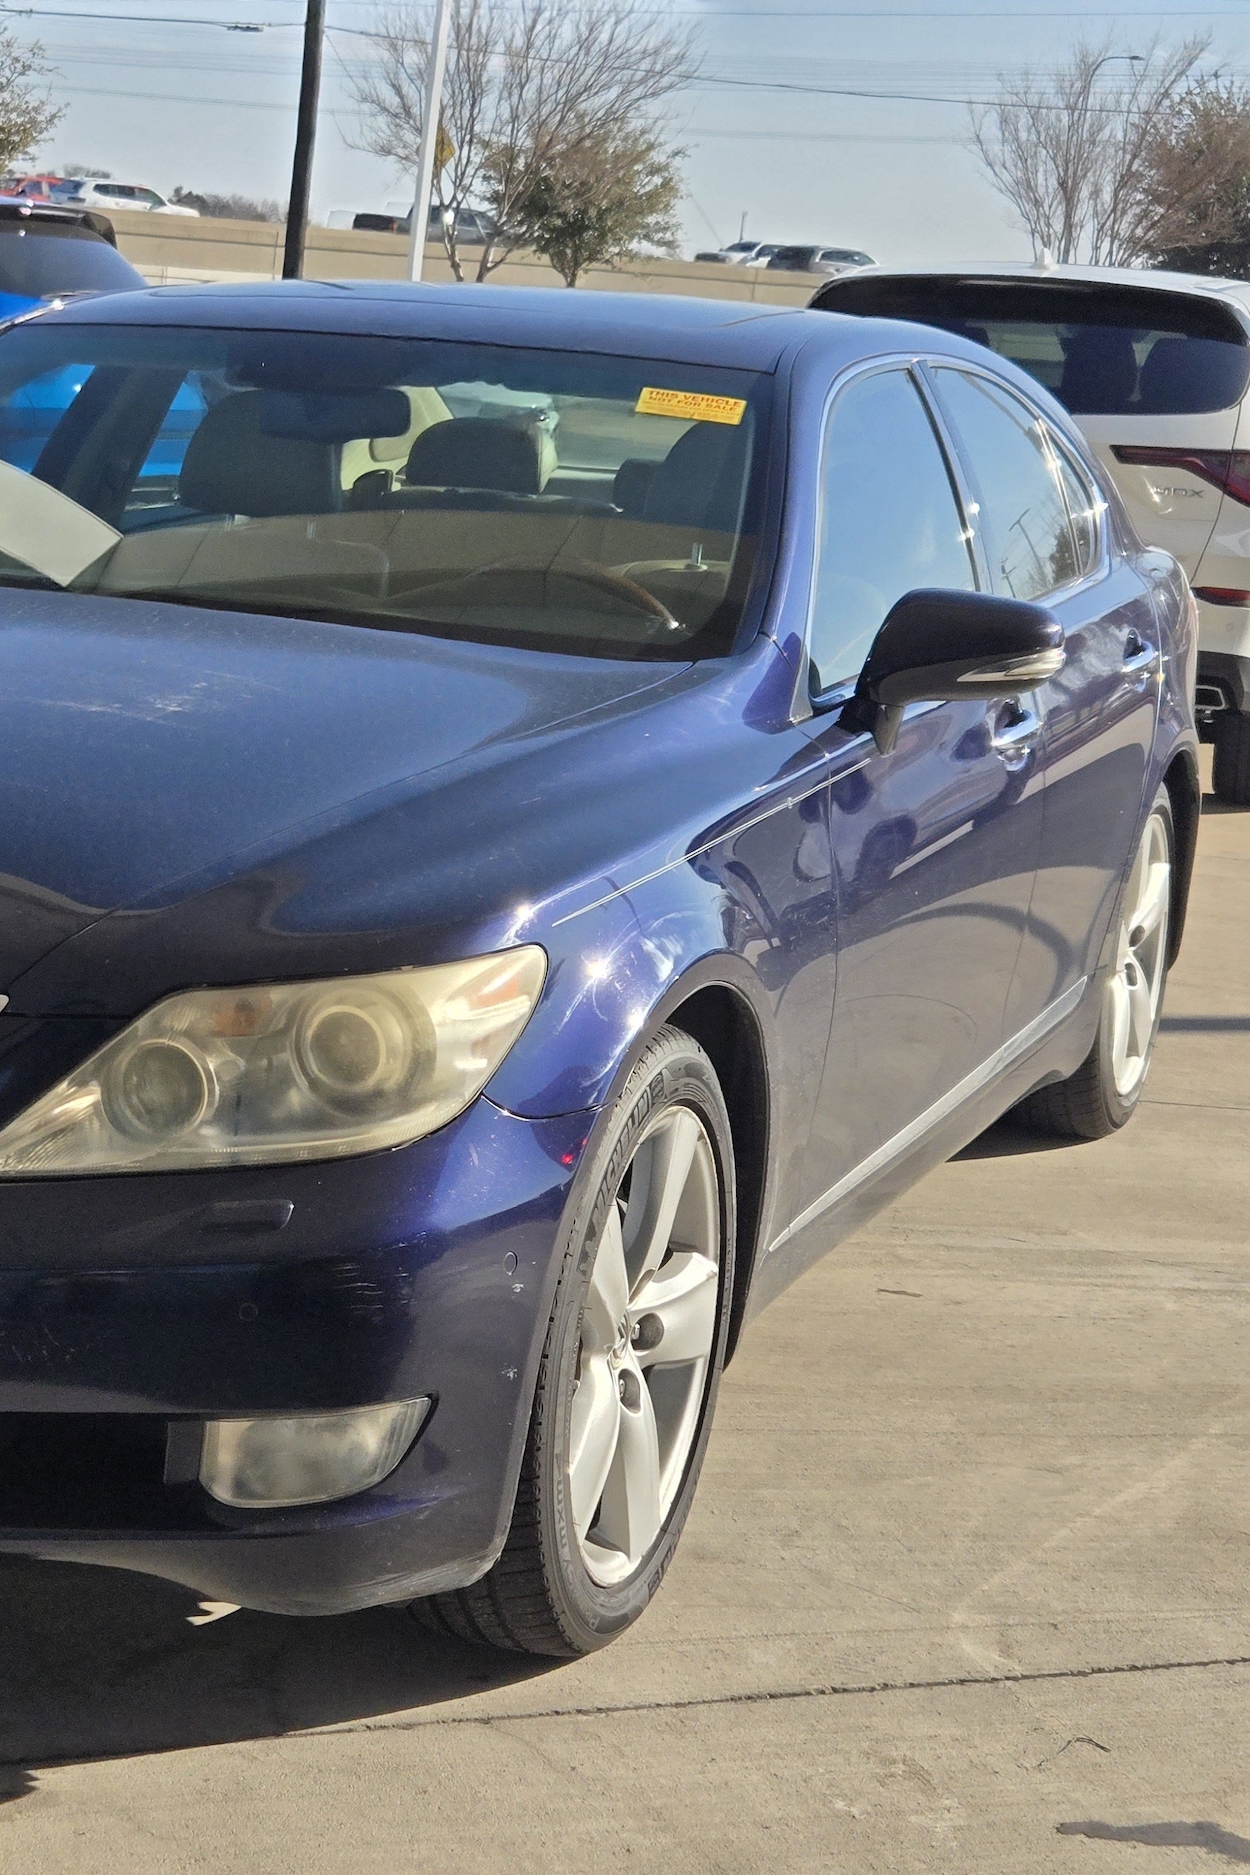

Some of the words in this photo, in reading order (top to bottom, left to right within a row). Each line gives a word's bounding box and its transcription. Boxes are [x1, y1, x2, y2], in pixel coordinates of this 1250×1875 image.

[649, 390, 678, 399] THIS
[683, 394, 742, 408] VEHICLE
[649, 396, 672, 404] NOT
[677, 399, 701, 408] FOR
[705, 403, 737, 412] SALE
